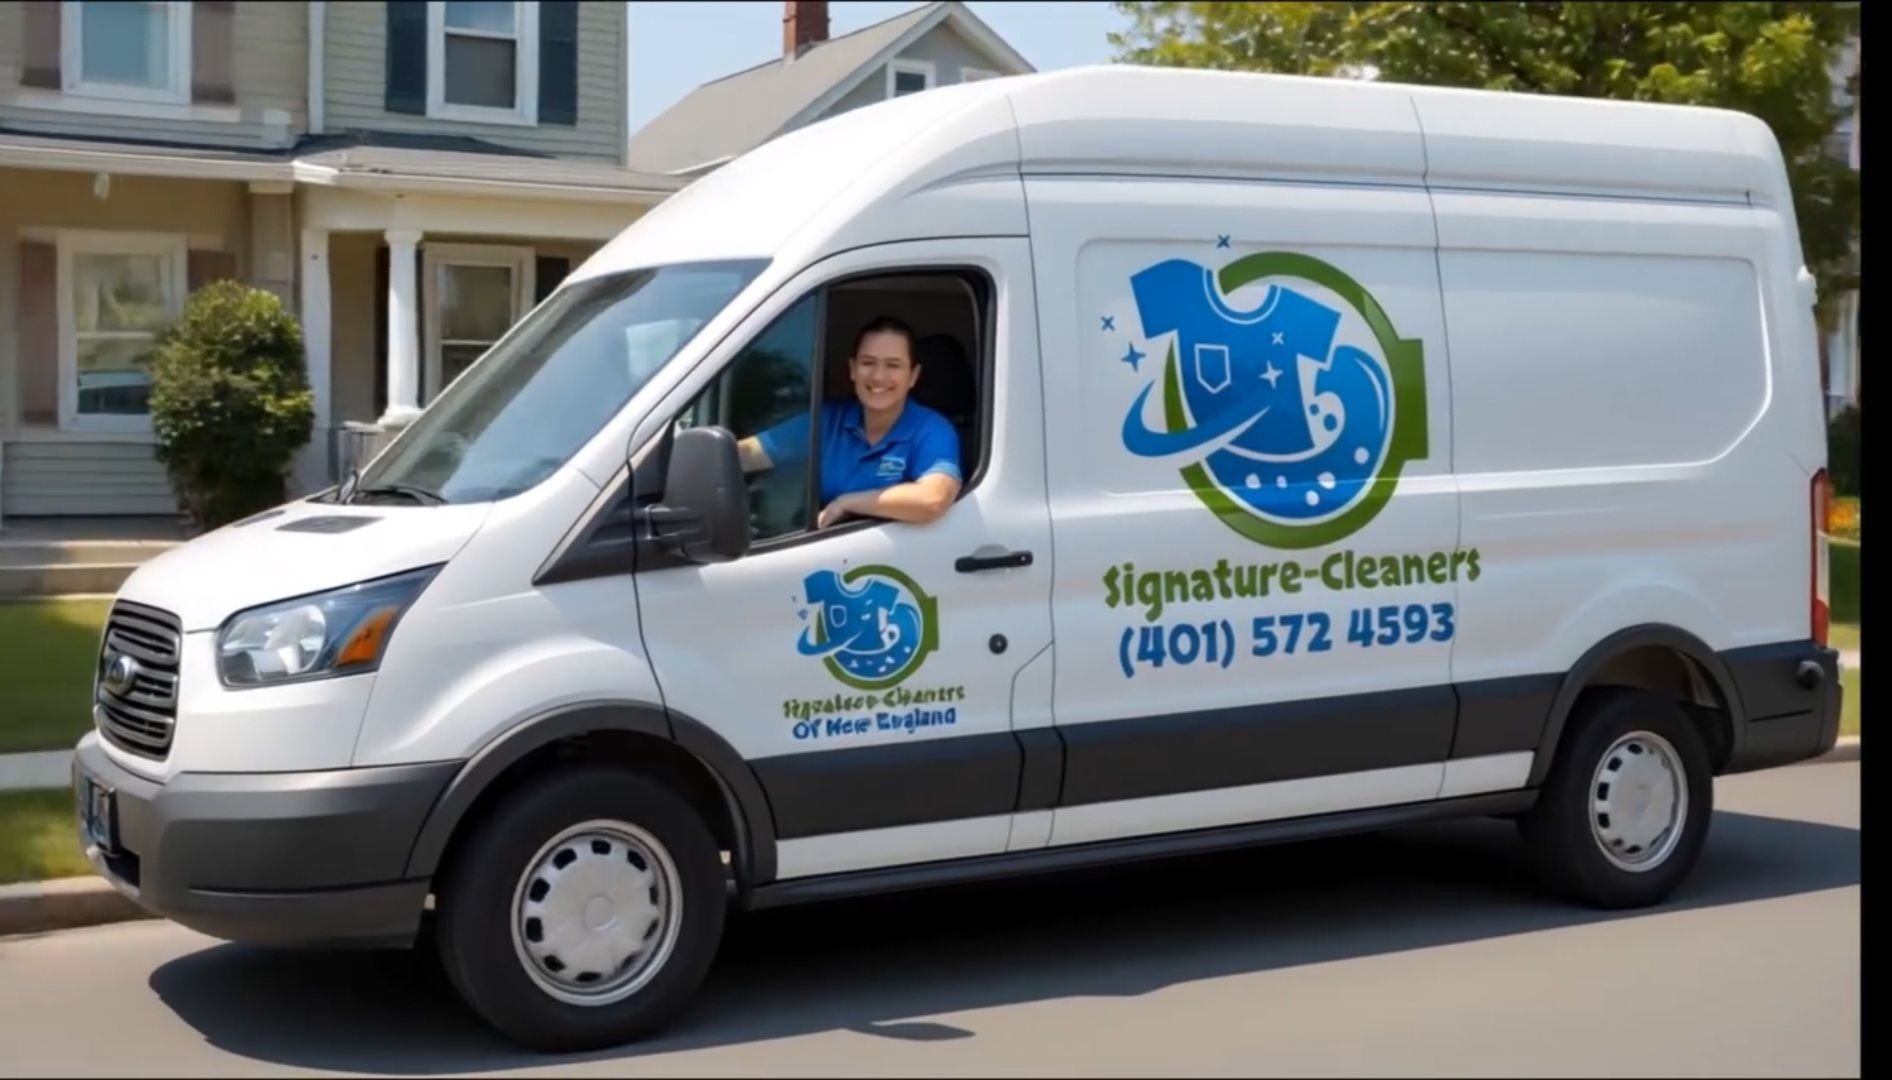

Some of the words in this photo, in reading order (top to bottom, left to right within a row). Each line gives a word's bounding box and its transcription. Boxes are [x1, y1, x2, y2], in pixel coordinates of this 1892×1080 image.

[1102, 548, 1481, 622] Signature-Cleaners
[1119, 619, 1235, 679] (401)
[1252, 612, 1332, 657] 572
[1346, 602, 1455, 647] 4593
